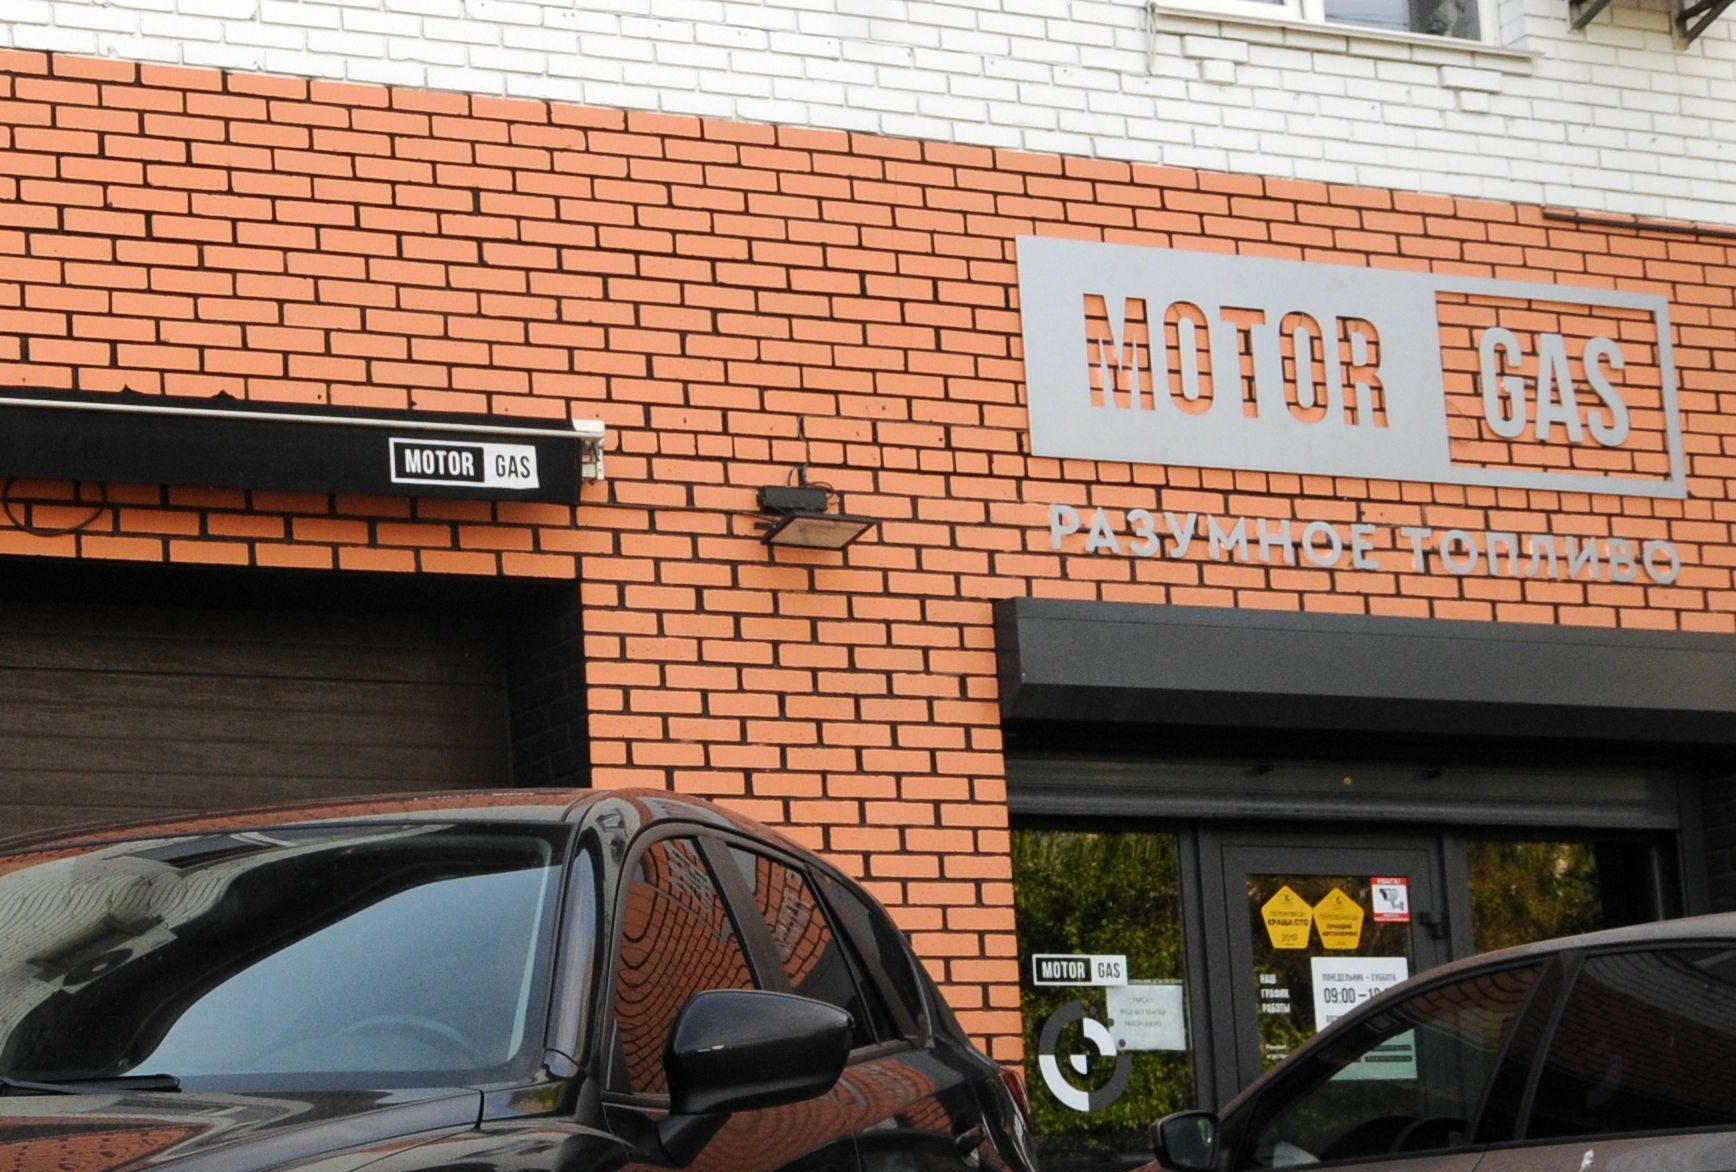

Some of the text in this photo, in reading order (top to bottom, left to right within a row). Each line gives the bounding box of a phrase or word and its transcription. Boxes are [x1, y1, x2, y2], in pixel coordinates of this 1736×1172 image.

[1082, 292, 1630, 447] MOTOR GAS
[404, 449, 531, 478] MOTOR GAS
[1048, 504, 1682, 585] РАЗУМНОЕ ТОПЛИВО
[1041, 960, 1121, 979] MOTOR GAS
[1323, 987, 1356, 1003] 09:00
